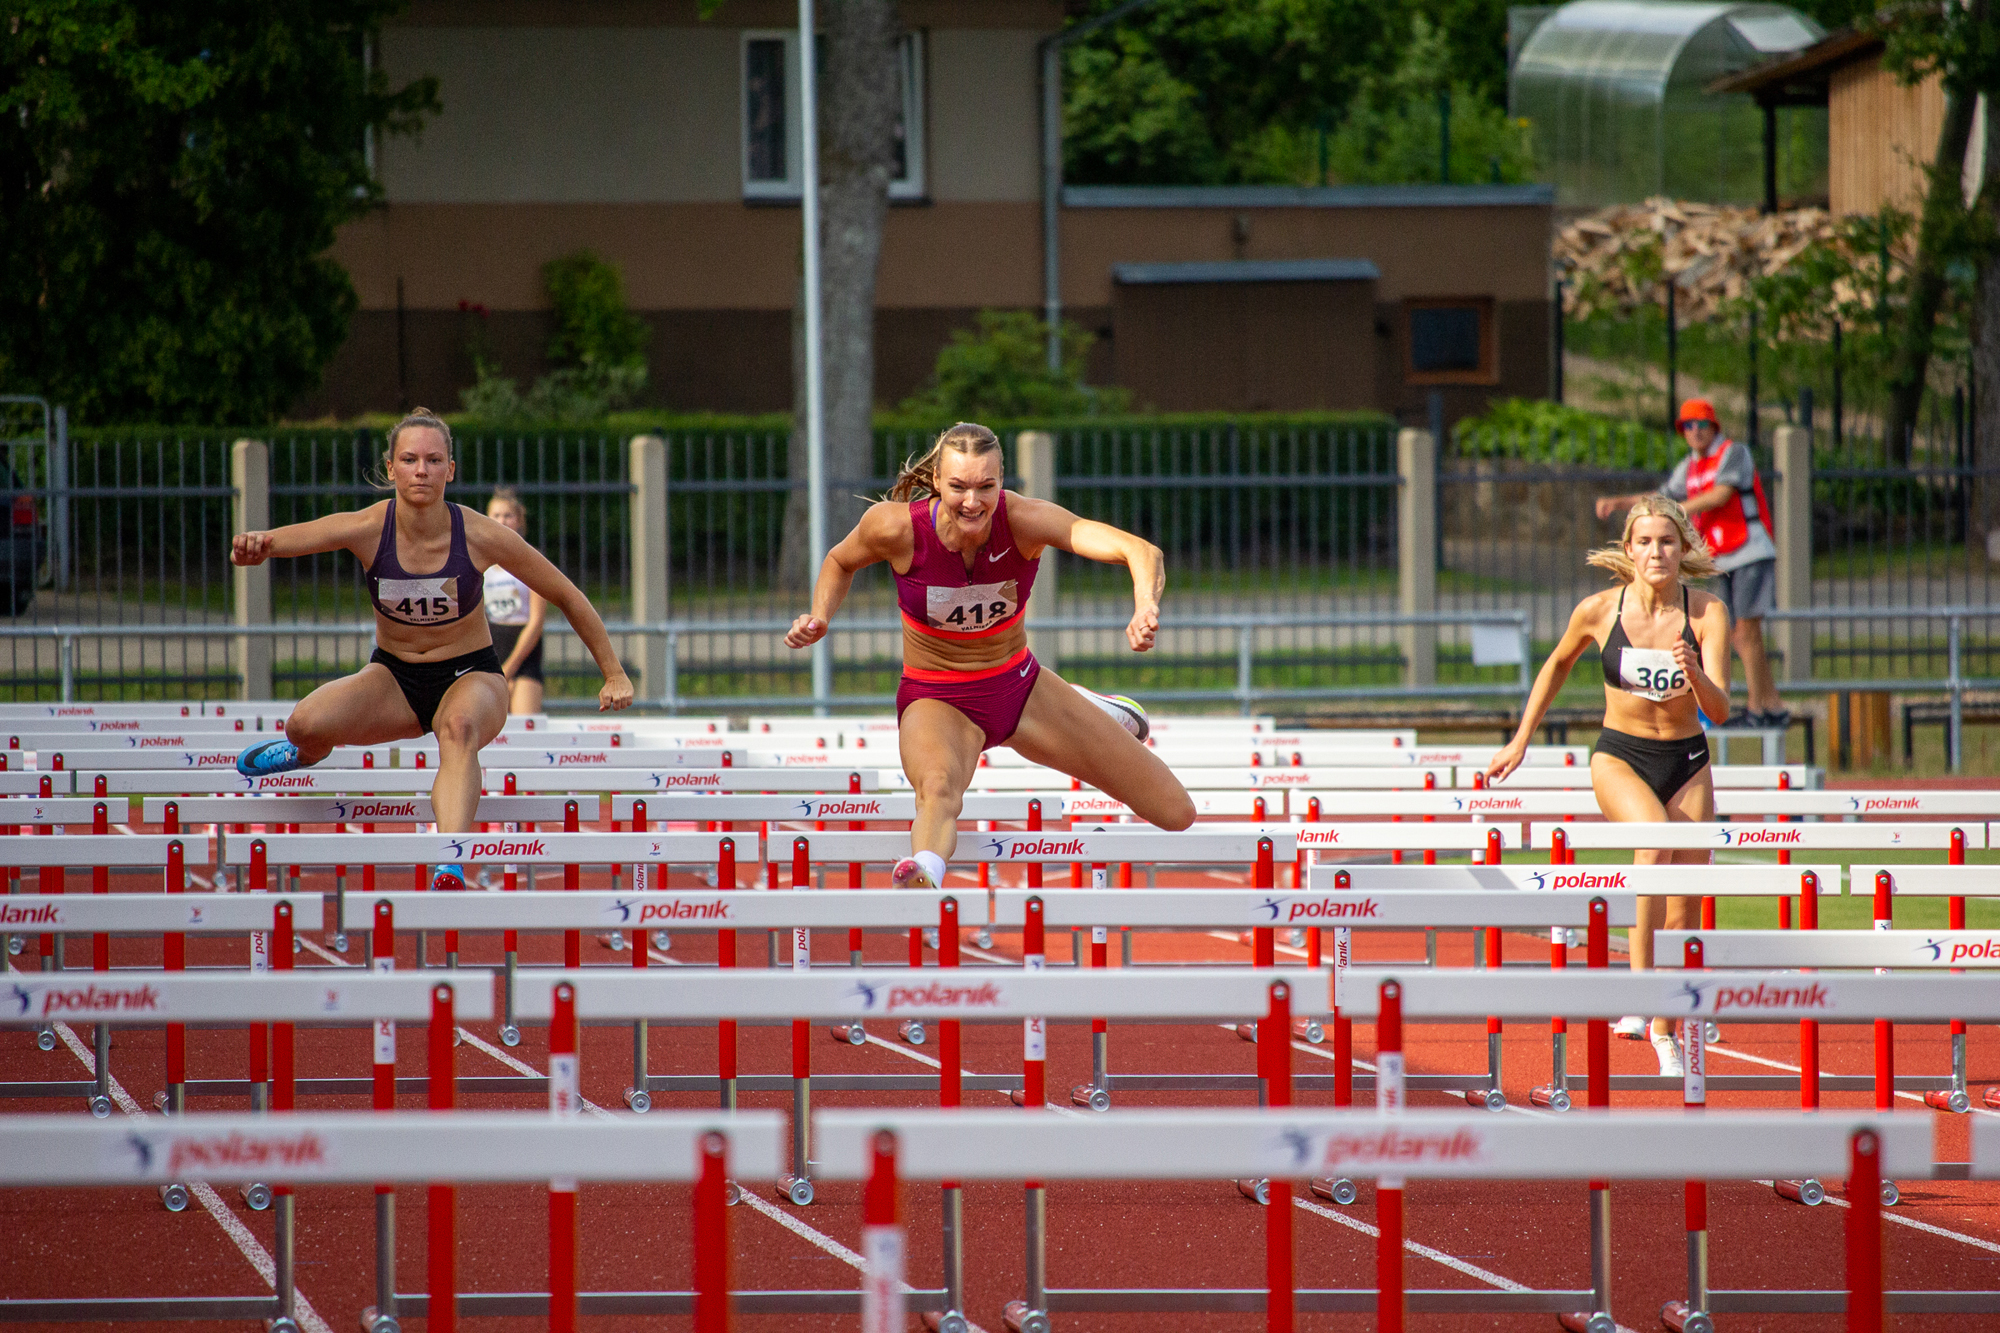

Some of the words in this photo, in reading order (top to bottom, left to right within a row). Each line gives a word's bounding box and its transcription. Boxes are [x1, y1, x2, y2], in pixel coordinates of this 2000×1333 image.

[395, 597, 449, 616] 415
[946, 601, 1007, 625] 418
[1635, 667, 1685, 692] 366
[58, 707, 94, 717] polanik
[101, 721, 140, 730] polanik
[141, 736, 184, 747] polanik
[198, 753, 237, 767] polan
[559, 752, 607, 765] polanik
[259, 774, 314, 790] polanik
[666, 774, 720, 788] polanik
[1264, 774, 1309, 784] polanik
[352, 801, 416, 818] polanik
[818, 799, 880, 816] polanik
[1469, 797, 1523, 810] polanik
[1865, 797, 1919, 811] polanik
[1297, 829, 1339, 843] lanik
[1738, 829, 1801, 845] polanik
[471, 838, 545, 860] polanik
[1010, 838, 1085, 859] polanik
[1552, 871, 1626, 890] polanik
[0, 904, 58, 924] lanik
[640, 899, 729, 923] polanik
[1289, 898, 1378, 922] polanik
[253, 930, 265, 955] pola
[1951, 939, 2000, 962] pola
[1337, 940, 1347, 969] lanik
[43, 984, 158, 1016] polanik
[887, 982, 1002, 1011] polanik
[1714, 982, 1829, 1013] polanik
[1689, 1023, 1700, 1076] polanik
